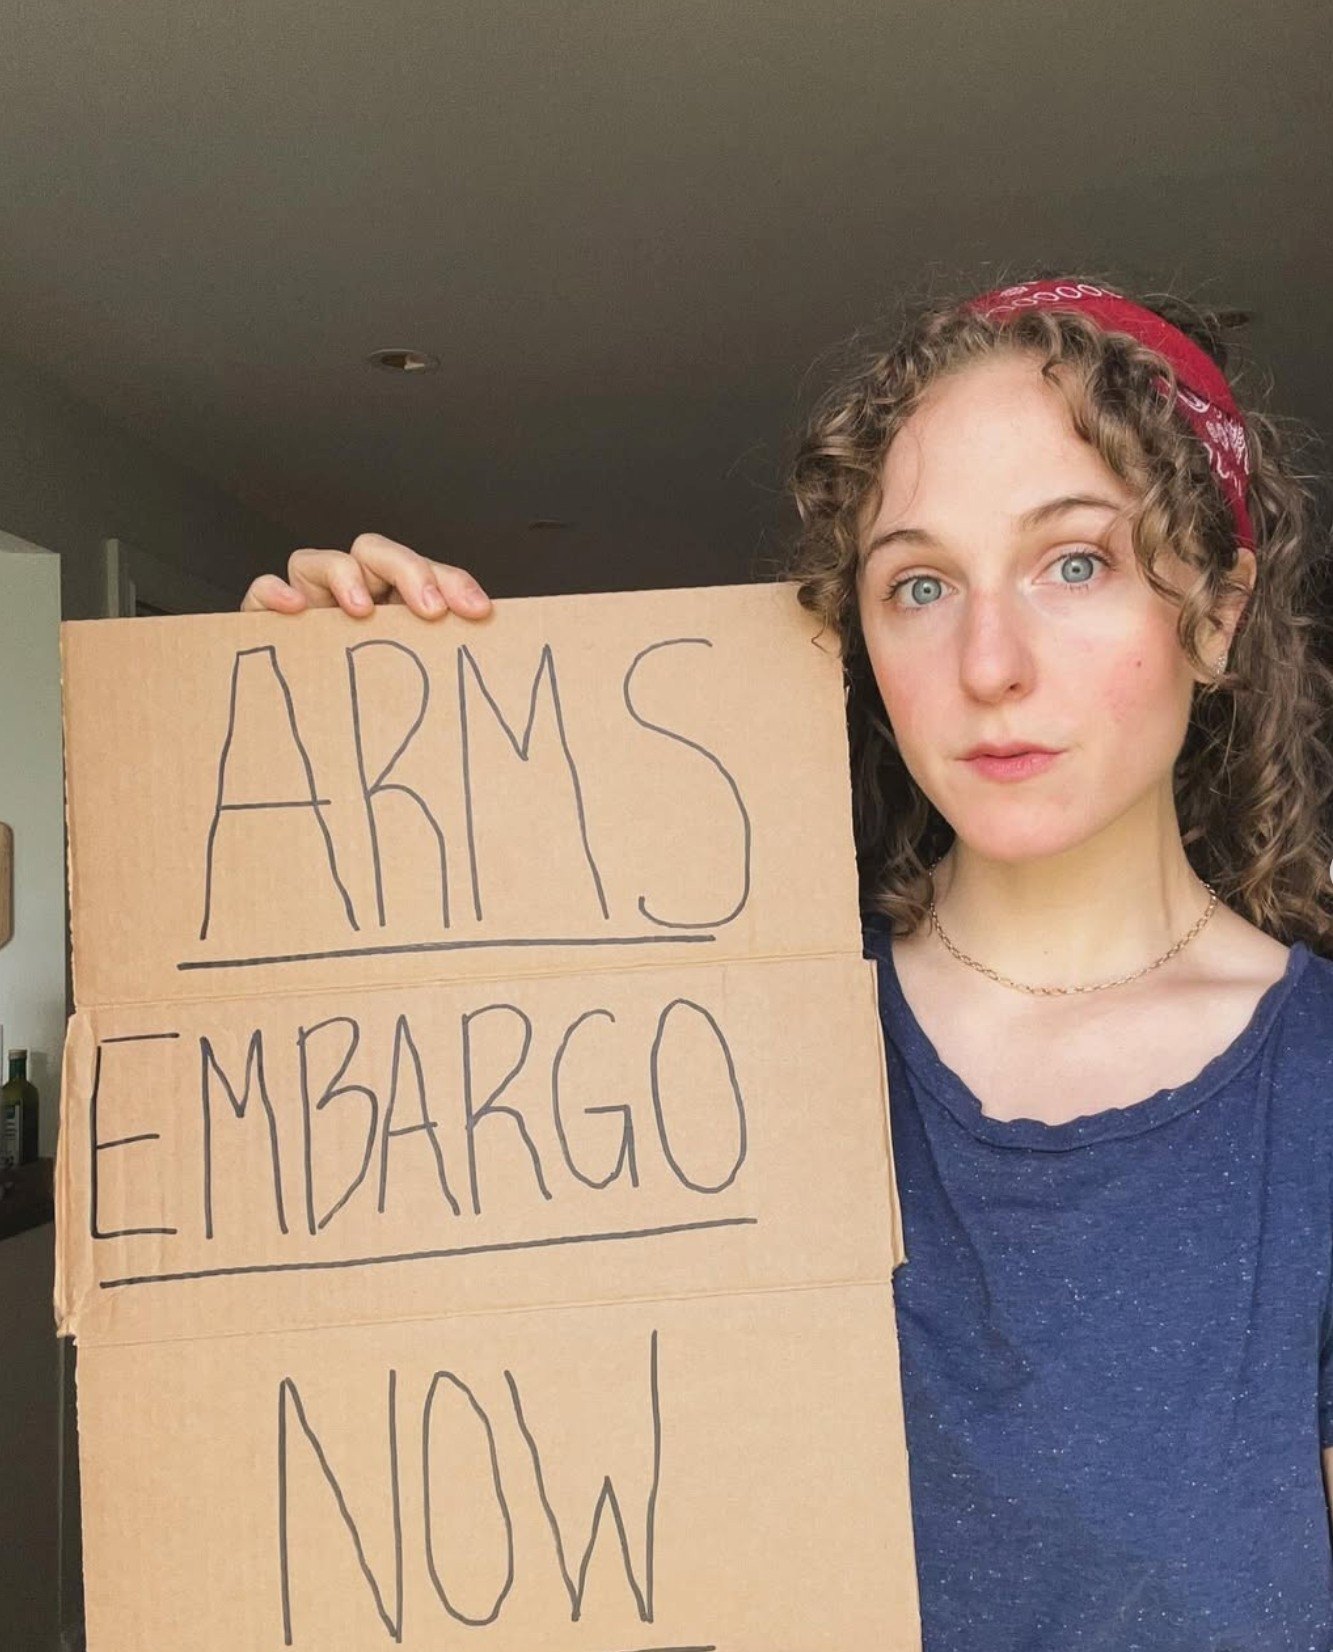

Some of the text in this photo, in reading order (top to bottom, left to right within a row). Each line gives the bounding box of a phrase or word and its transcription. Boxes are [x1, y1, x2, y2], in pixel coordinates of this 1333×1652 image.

[199, 638, 752, 942] ARMS
[90, 998, 748, 1241] EMBARGO
[278, 1329, 662, 1647] NOW
